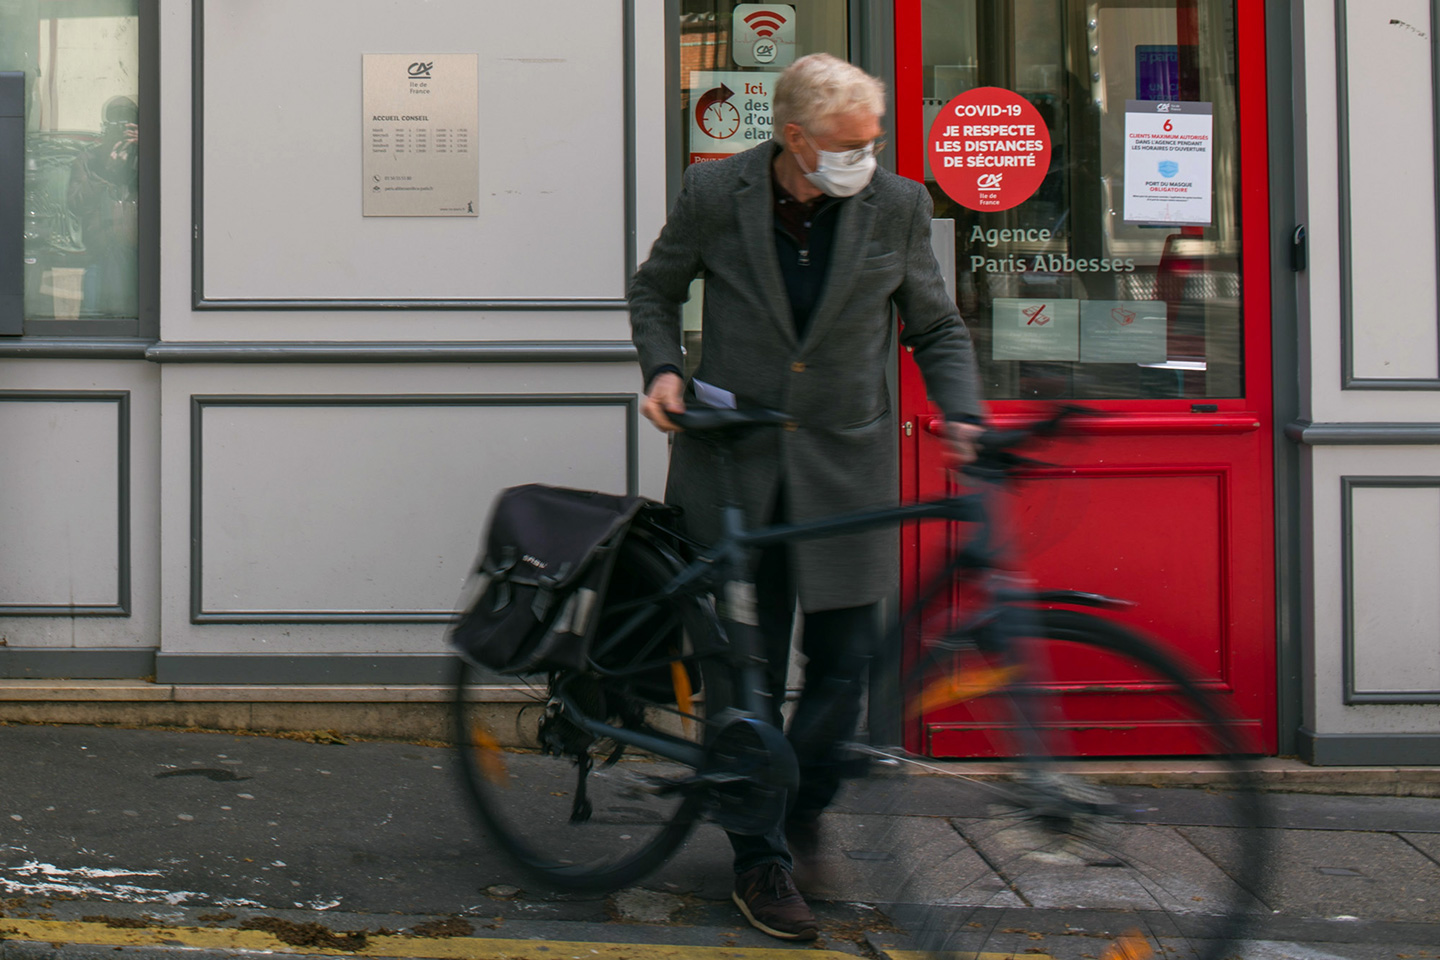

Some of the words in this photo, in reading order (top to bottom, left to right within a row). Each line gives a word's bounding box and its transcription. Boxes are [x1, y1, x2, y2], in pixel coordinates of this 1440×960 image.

[744, 82, 767, 97] Ici,
[744, 99, 769, 111] des
[955, 105, 1022, 117] COVID-19
[942, 126, 960, 137] JE
[963, 125, 1036, 136] RESPECTE
[1163, 119, 1173, 132] 6
[935, 141, 961, 152] LES
[965, 140, 1044, 152] DISTANCES
[944, 156, 963, 167] DE
[966, 153, 1036, 167] SÉCURITÉ
[970, 225, 1051, 247] Agence
[970, 254, 1027, 273] Paris
[1033, 253, 1136, 272] Abbesses
